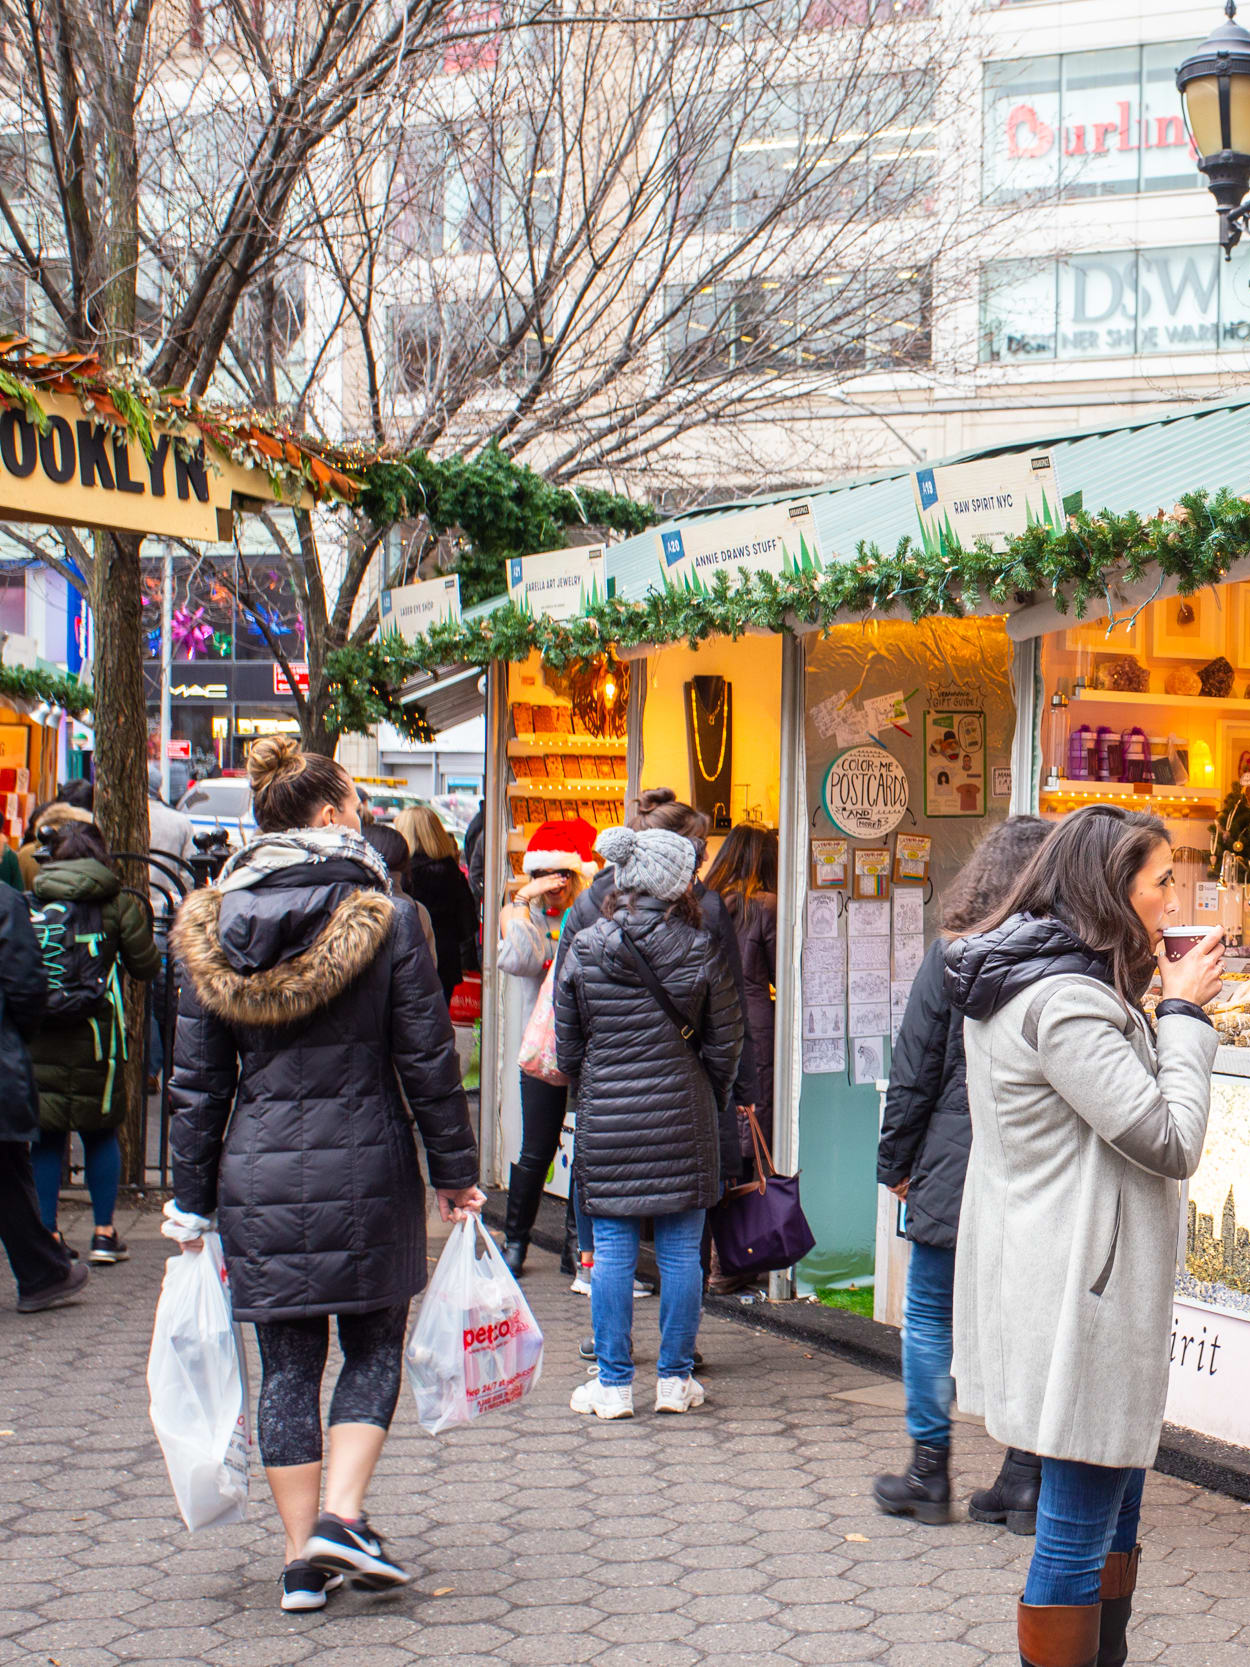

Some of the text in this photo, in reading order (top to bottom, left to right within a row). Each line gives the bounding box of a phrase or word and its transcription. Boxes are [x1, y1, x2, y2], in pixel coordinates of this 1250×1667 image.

[1071, 254, 1221, 324] DSW
[922, 480, 934, 495] A19
[954, 493, 1013, 515] RAW SPIRIT NYC
[667, 539, 680, 554] A20
[695, 538, 777, 568] ANNIE DRAWS STUFF
[546, 578, 556, 590] ART
[557, 575, 582, 589] JEWELRY
[841, 757, 894, 773] COLOR-ME
[830, 772, 908, 808] POSTCARDS
[847, 809, 869, 819] AND
